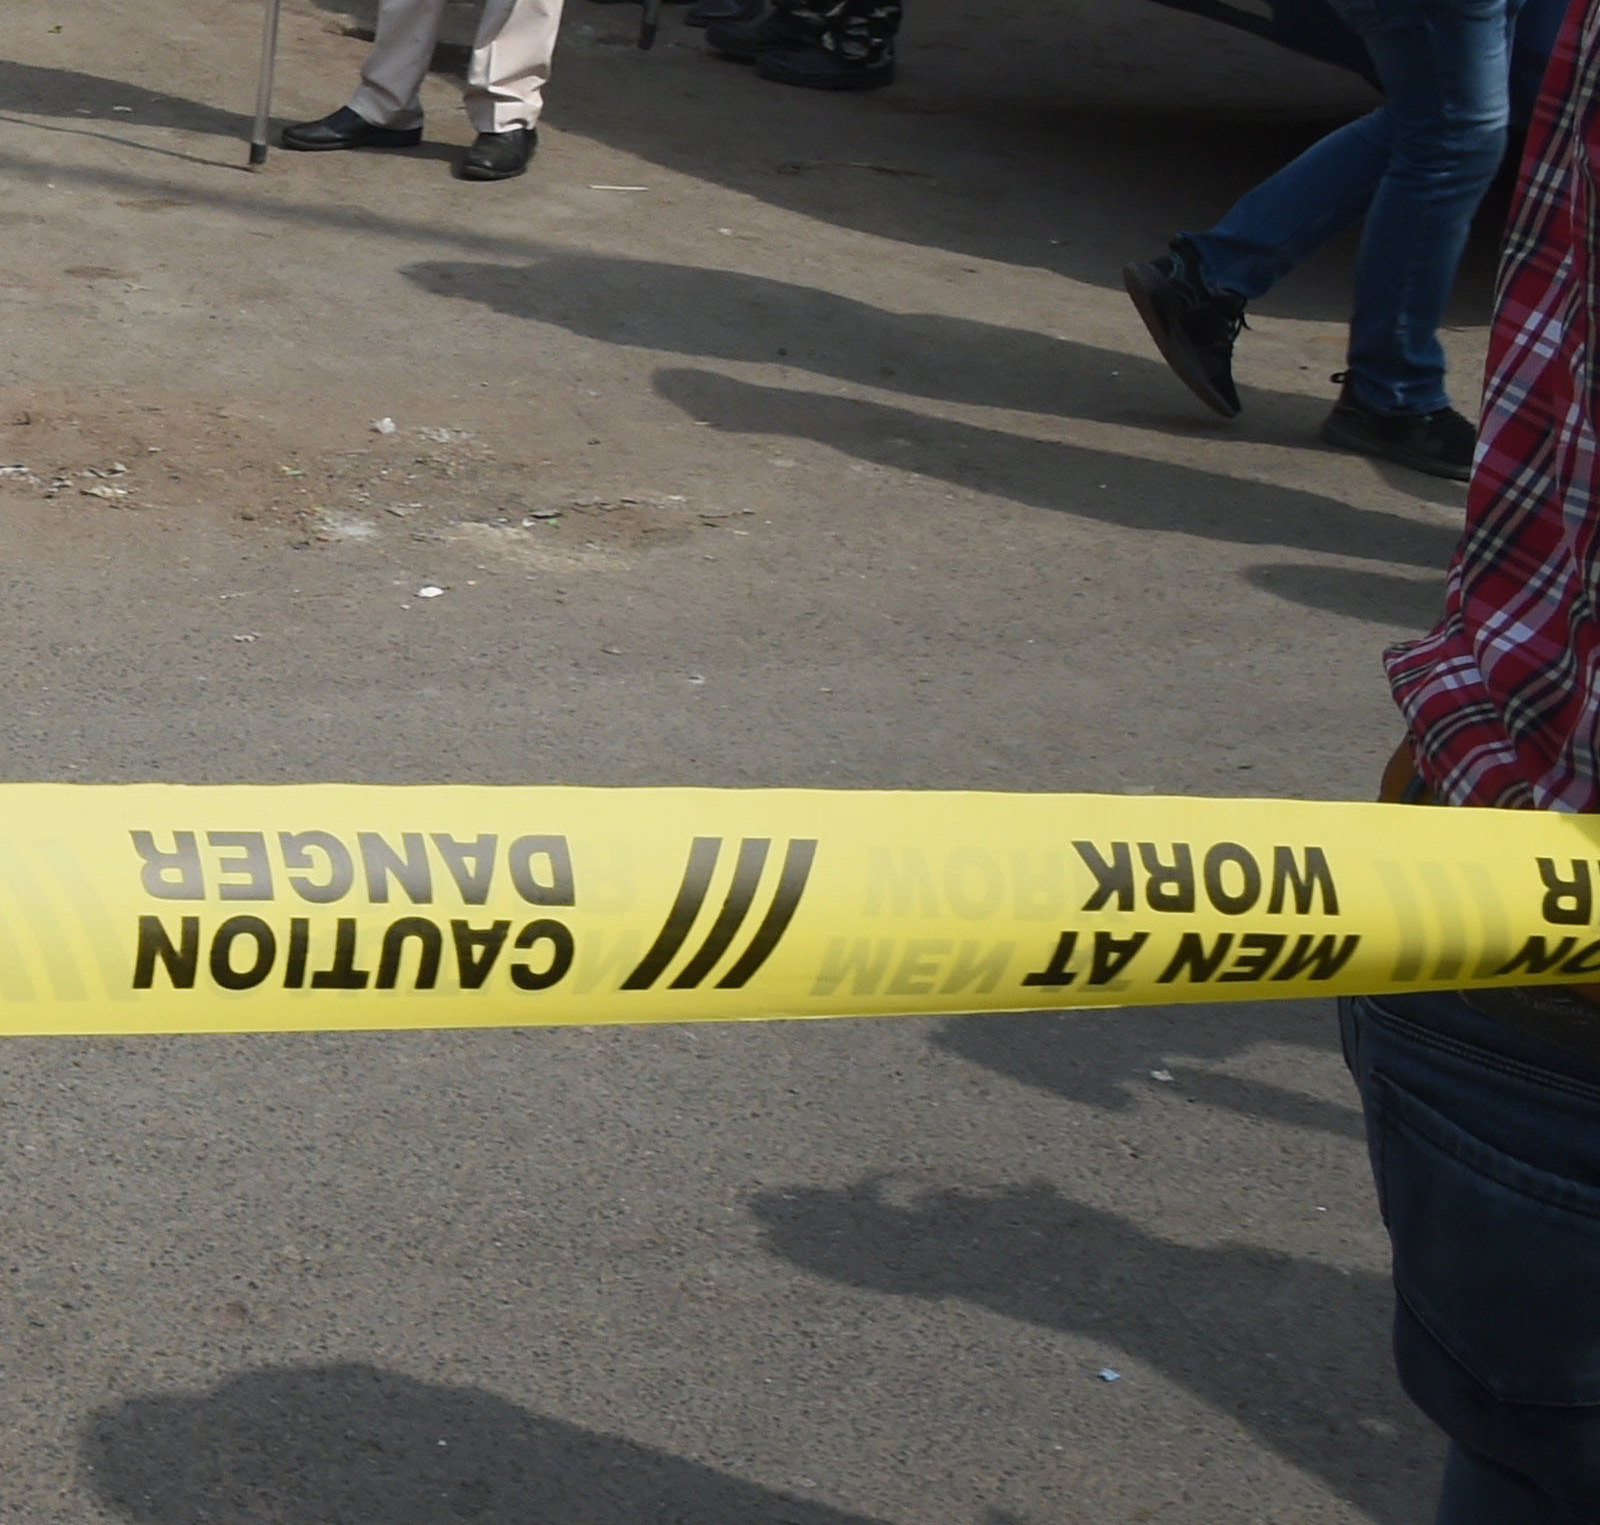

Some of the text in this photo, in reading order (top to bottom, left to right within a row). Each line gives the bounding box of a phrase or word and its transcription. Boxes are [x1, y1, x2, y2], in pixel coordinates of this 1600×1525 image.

[129, 829, 576, 907] DANGER
[1068, 839, 1339, 917] WORK
[132, 914, 576, 991] CAUTION
[1022, 930, 1135, 987] AT
[1157, 932, 1360, 984] MEN
